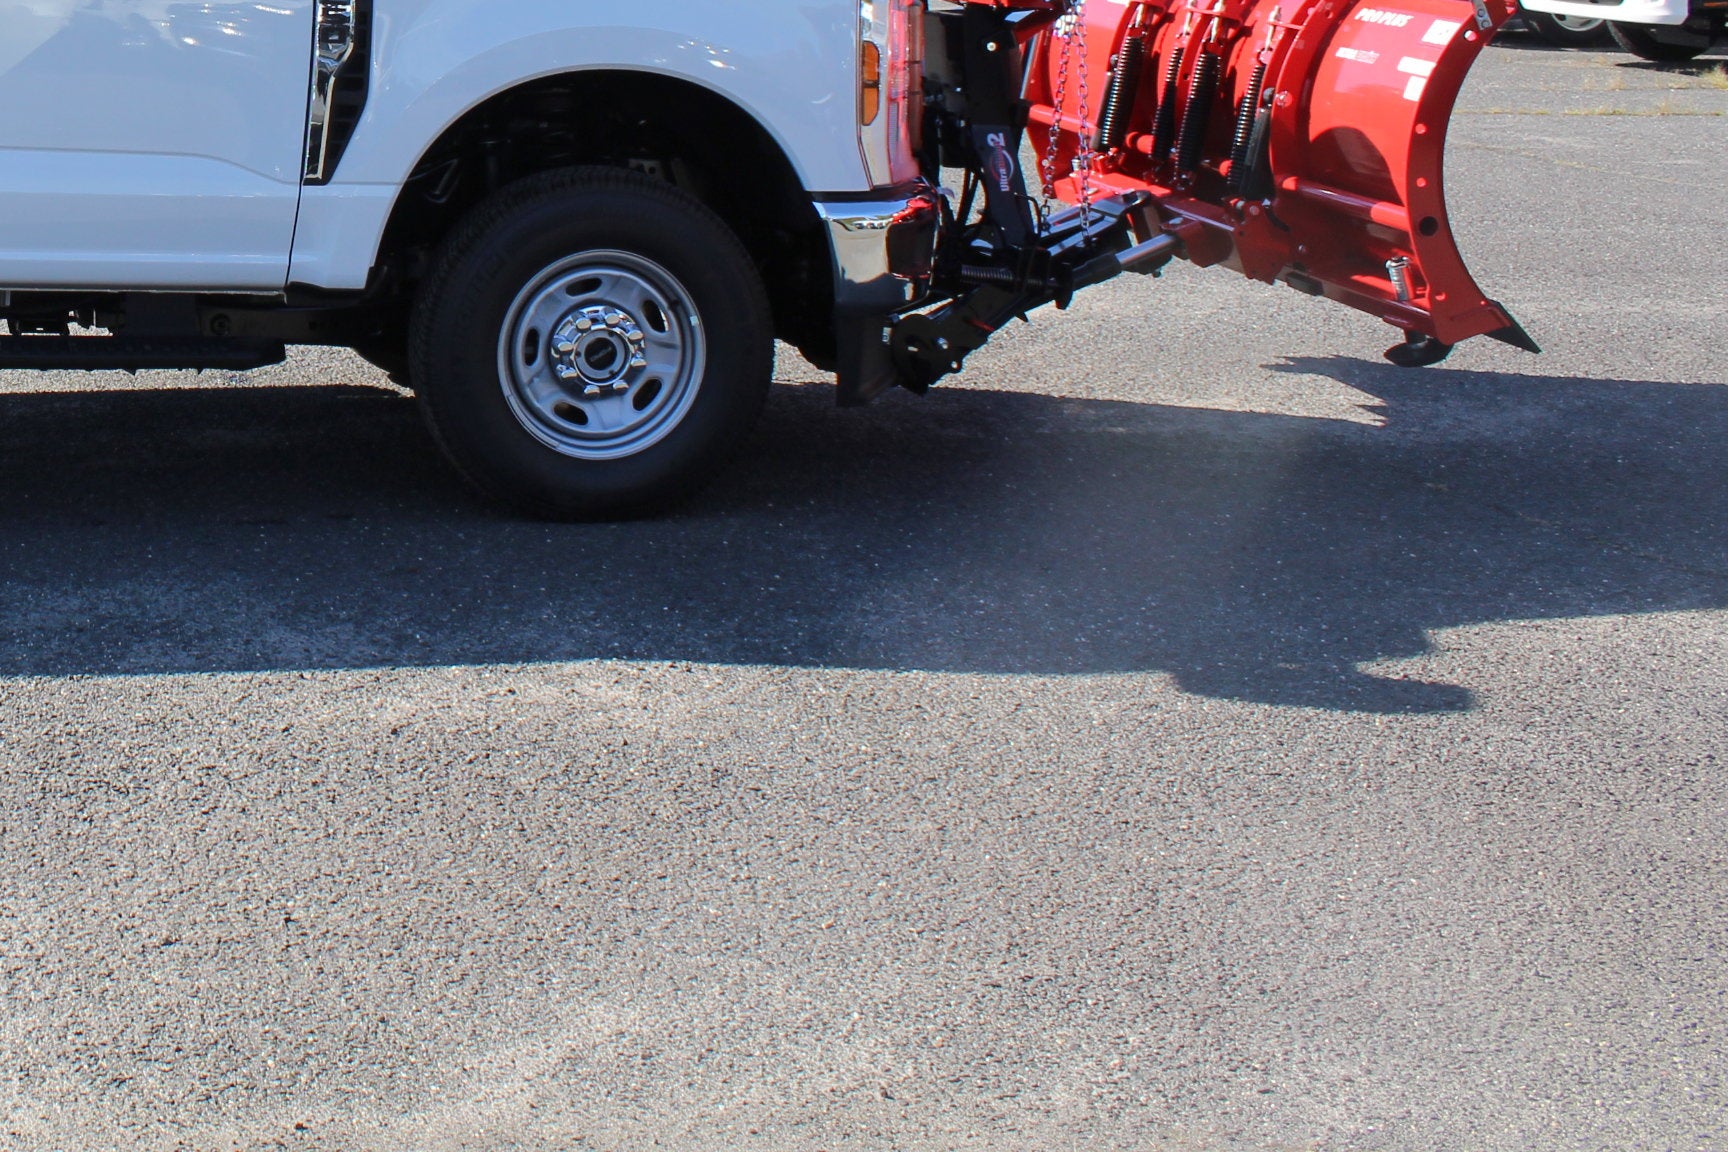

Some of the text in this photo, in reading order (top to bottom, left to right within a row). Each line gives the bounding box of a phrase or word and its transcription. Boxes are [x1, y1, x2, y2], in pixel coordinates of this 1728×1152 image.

[1354, 8, 1415, 28] PRO PLUS
[986, 132, 1006, 147] 2
